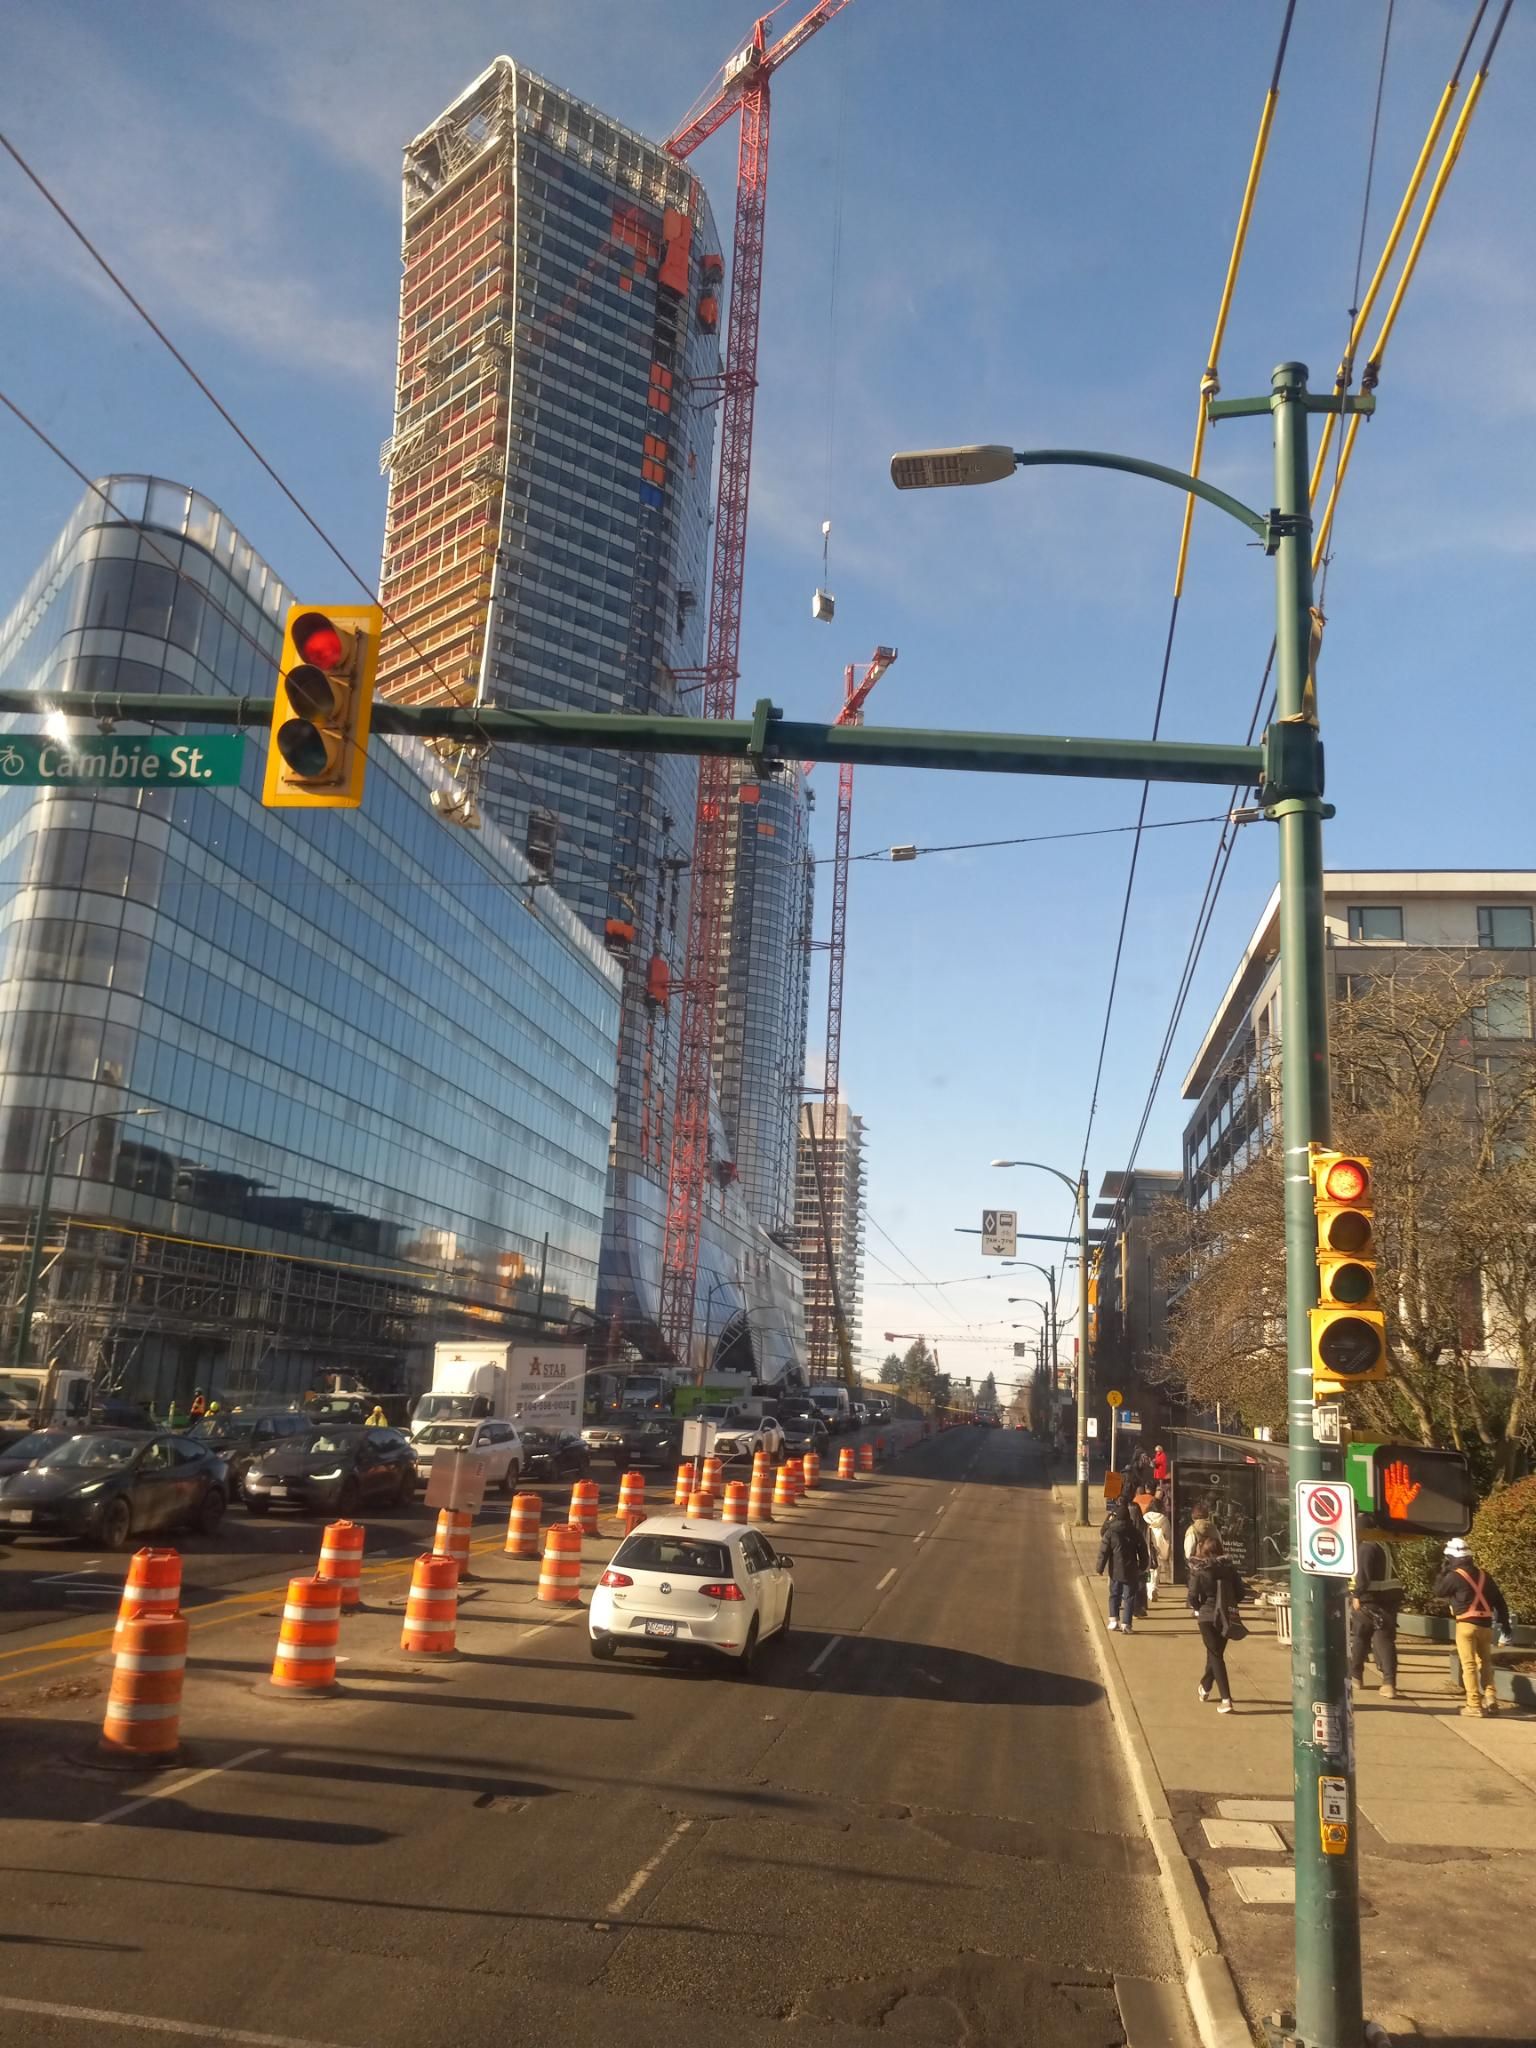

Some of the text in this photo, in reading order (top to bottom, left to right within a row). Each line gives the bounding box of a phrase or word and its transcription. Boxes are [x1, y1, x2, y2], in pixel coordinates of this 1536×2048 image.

[38, 746, 213, 778] Cambie St.
[529, 1357, 566, 1376] A STAR
